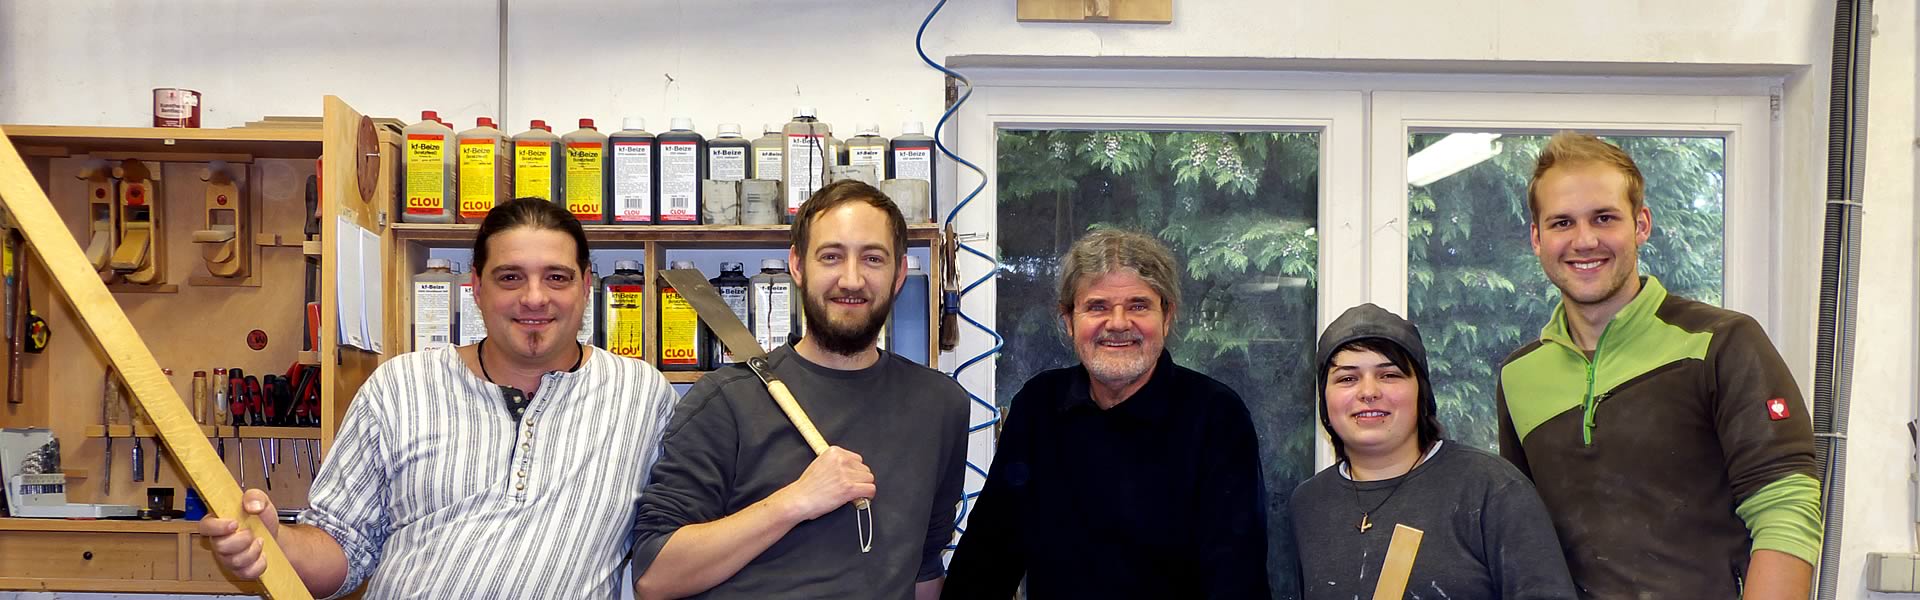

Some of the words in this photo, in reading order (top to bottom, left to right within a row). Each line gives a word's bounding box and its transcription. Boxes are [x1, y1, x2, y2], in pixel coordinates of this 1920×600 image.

[411, 143, 440, 151] kf-Beize
[464, 147, 491, 155] kf-Beize
[519, 149, 547, 157] kf-Beize
[570, 150, 598, 158] kf-Beize
[899, 150, 926, 158] kf-Beize
[410, 197, 440, 207] CLOU
[463, 201, 491, 210] CLOU
[570, 203, 599, 213] CLOU
[610, 346, 638, 356] CLOU
[665, 348, 694, 358] CLOU
